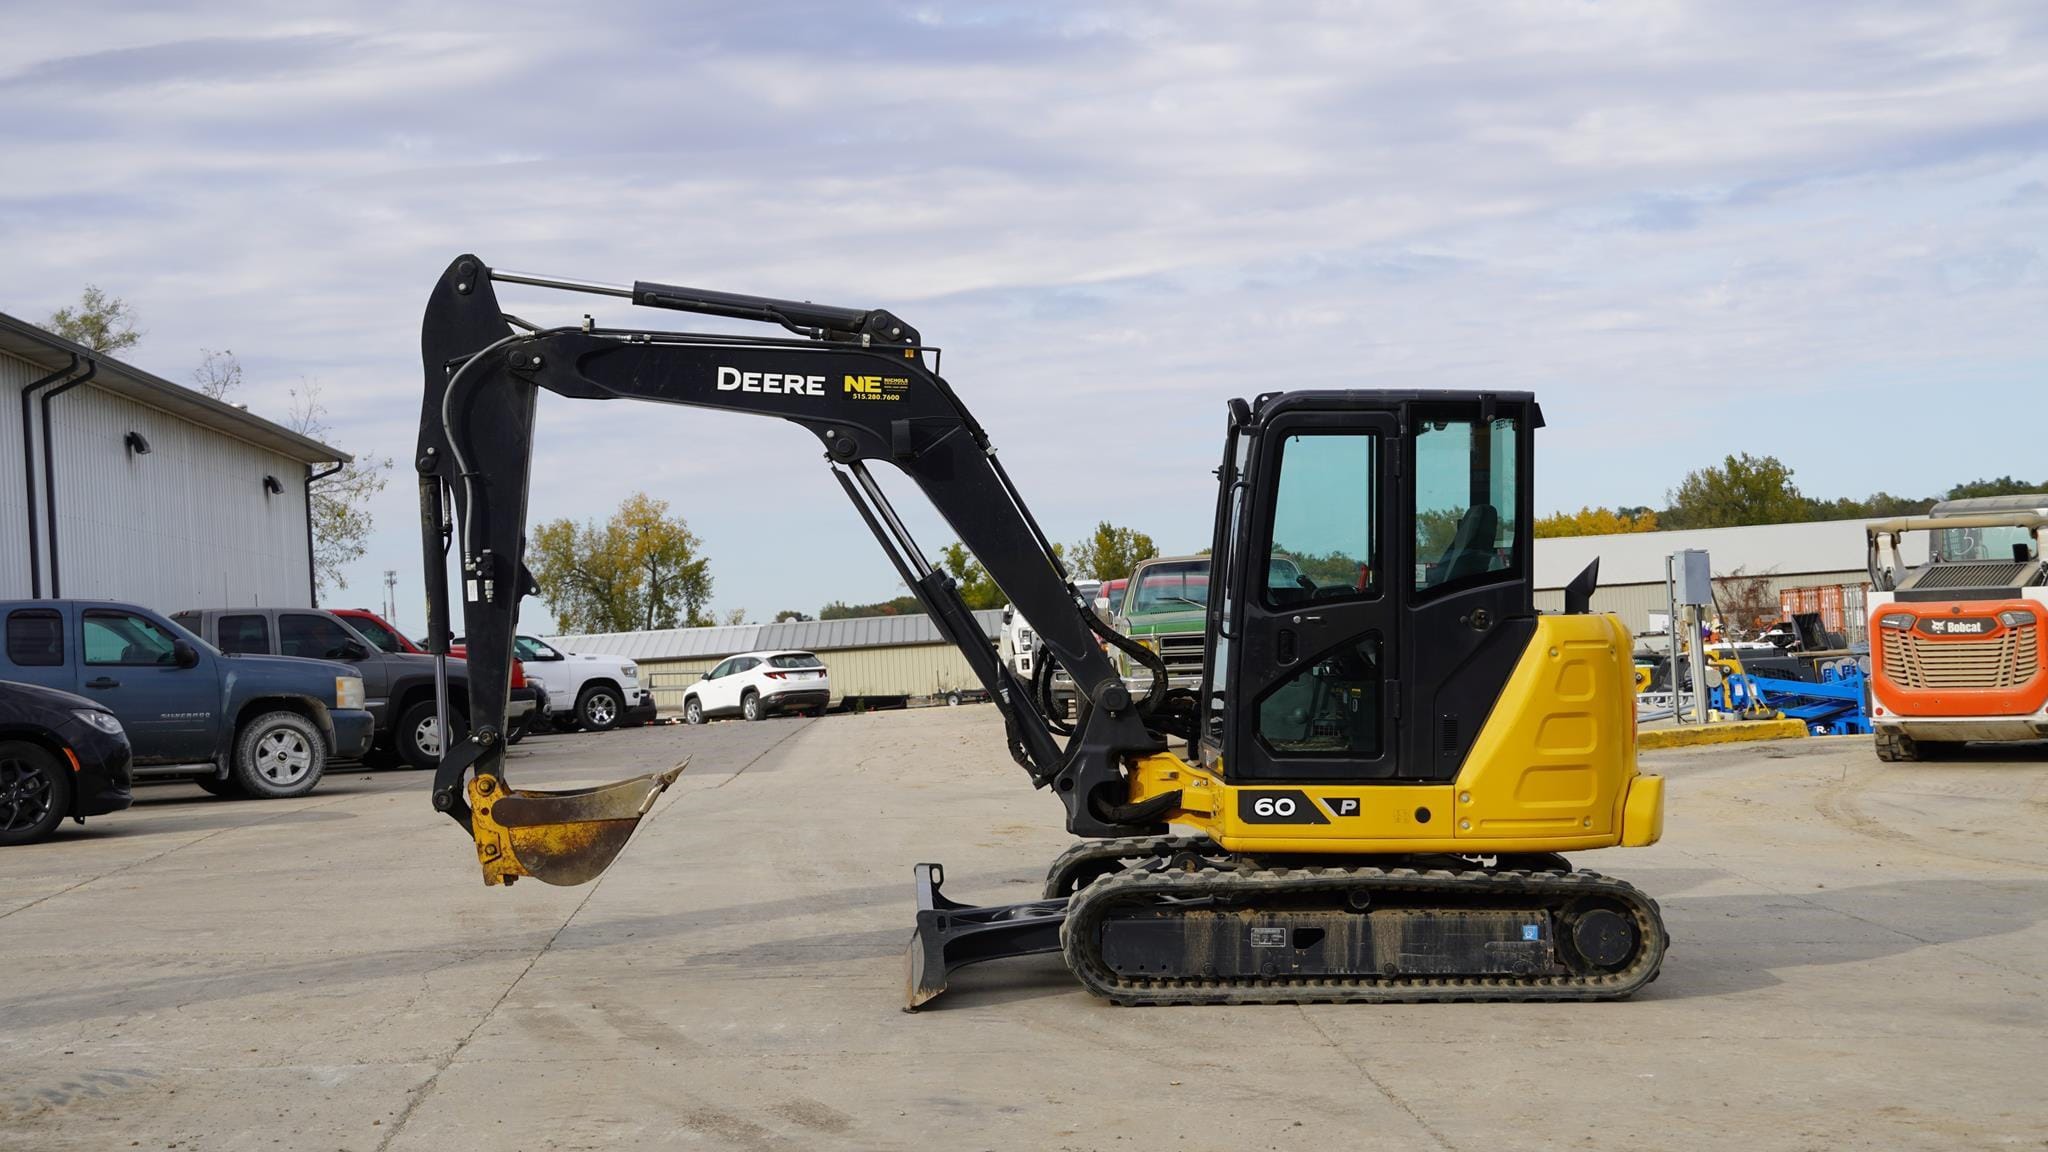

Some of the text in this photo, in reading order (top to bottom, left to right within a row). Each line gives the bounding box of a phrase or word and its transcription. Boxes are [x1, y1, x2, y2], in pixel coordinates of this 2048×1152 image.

[717, 366, 826, 396] DEERE
[844, 375, 882, 393] NE
[852, 393, 900, 401] 515.280.7600
[1947, 622, 1981, 633] Bobcat
[1254, 797, 1296, 817] 60
[1340, 799, 1357, 815] P
